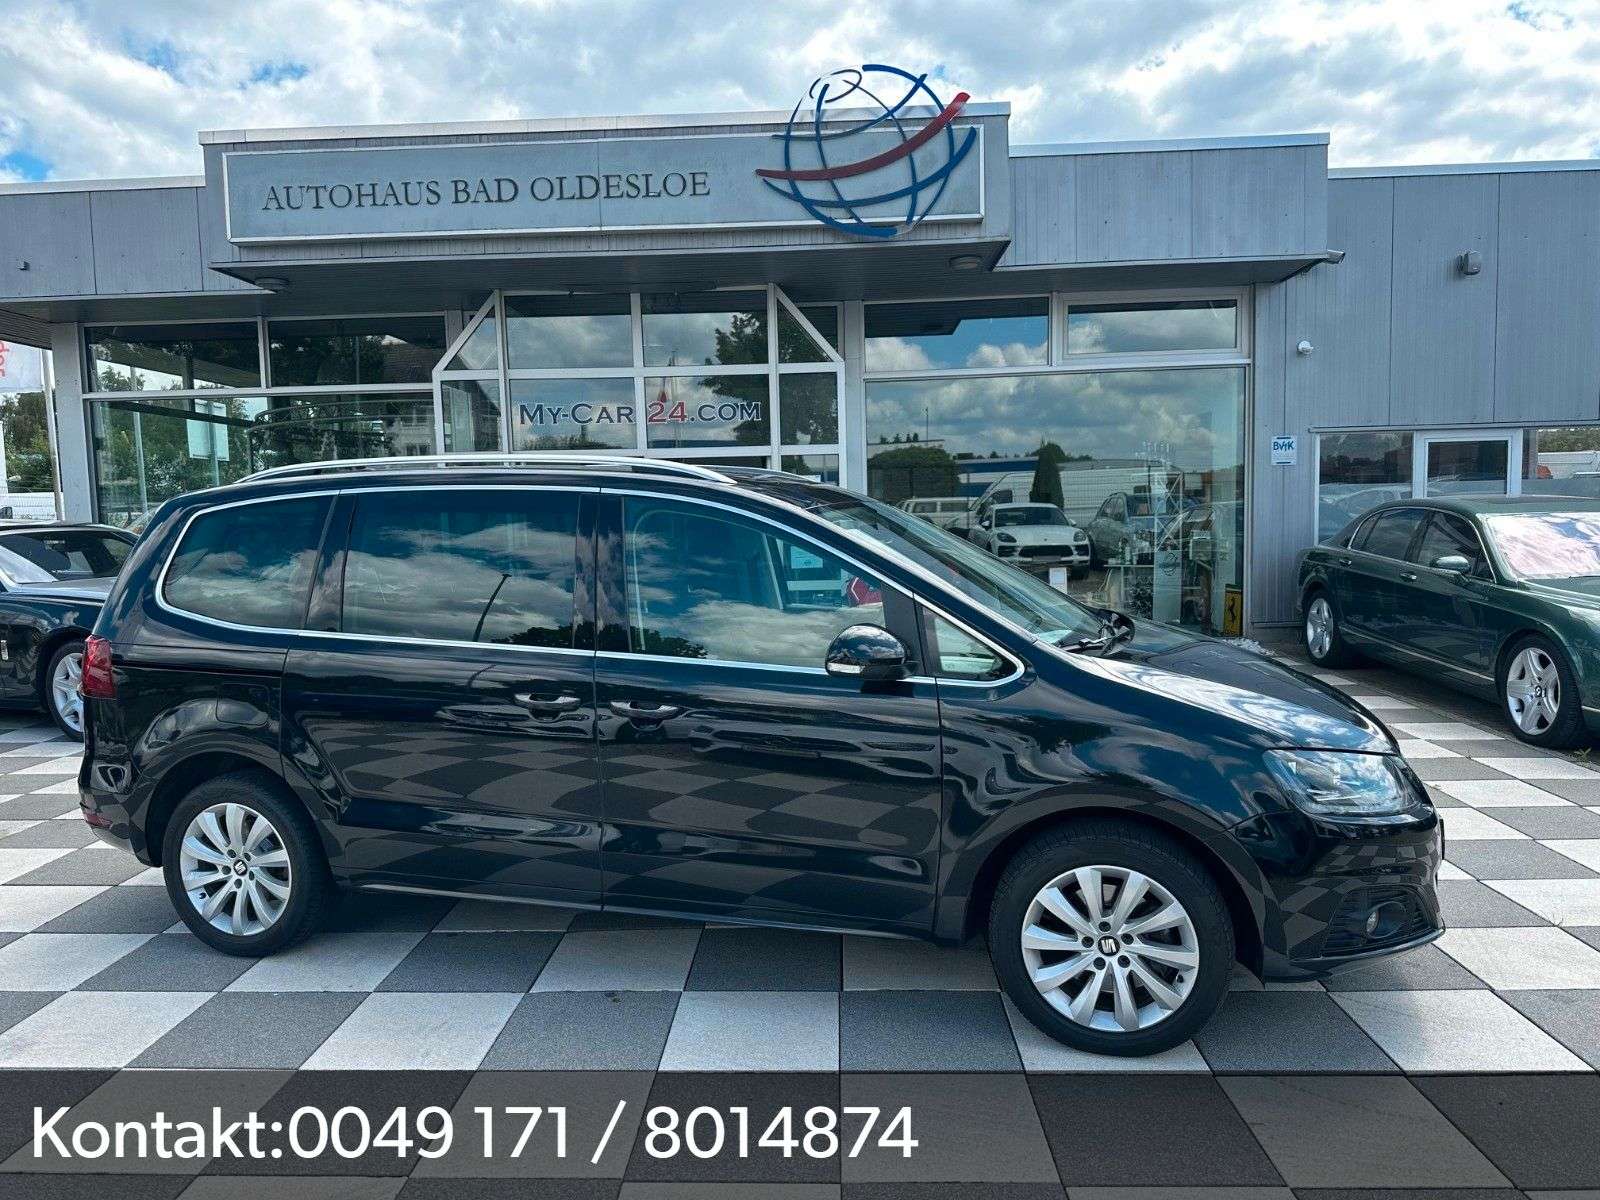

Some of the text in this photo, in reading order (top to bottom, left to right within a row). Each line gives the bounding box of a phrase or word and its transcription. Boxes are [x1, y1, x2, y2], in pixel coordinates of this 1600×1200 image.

[262, 172, 711, 210] AUTOHAUS BAD OLDESLOE
